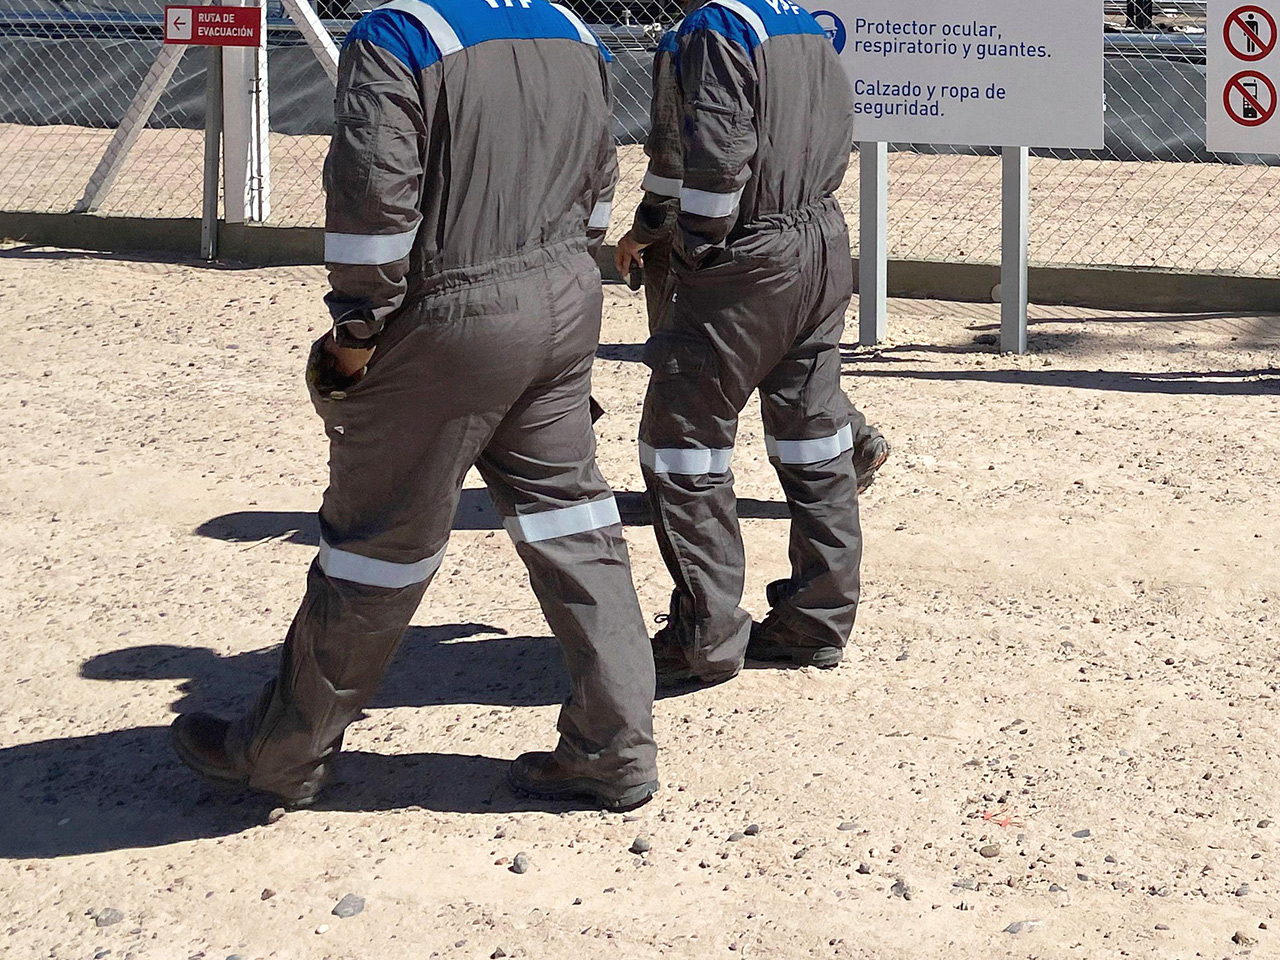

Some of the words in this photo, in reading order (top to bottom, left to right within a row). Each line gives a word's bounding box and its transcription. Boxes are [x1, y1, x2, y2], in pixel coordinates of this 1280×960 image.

[198, 13, 222, 24] RUTA
[223, 13, 235, 23] DE
[197, 25, 254, 38] EVACUACIÓN
[855, 18, 937, 36] Protector
[942, 20, 1002, 42] ocular,
[855, 38, 957, 58] respiratorio
[962, 43, 972, 60] y
[976, 41, 1051, 60] guantes.
[854, 79, 922, 97] Calzado
[926, 85, 936, 102] y
[941, 86, 980, 103] ropa
[985, 82, 1006, 100] de
[853, 99, 945, 119] seguridad.
